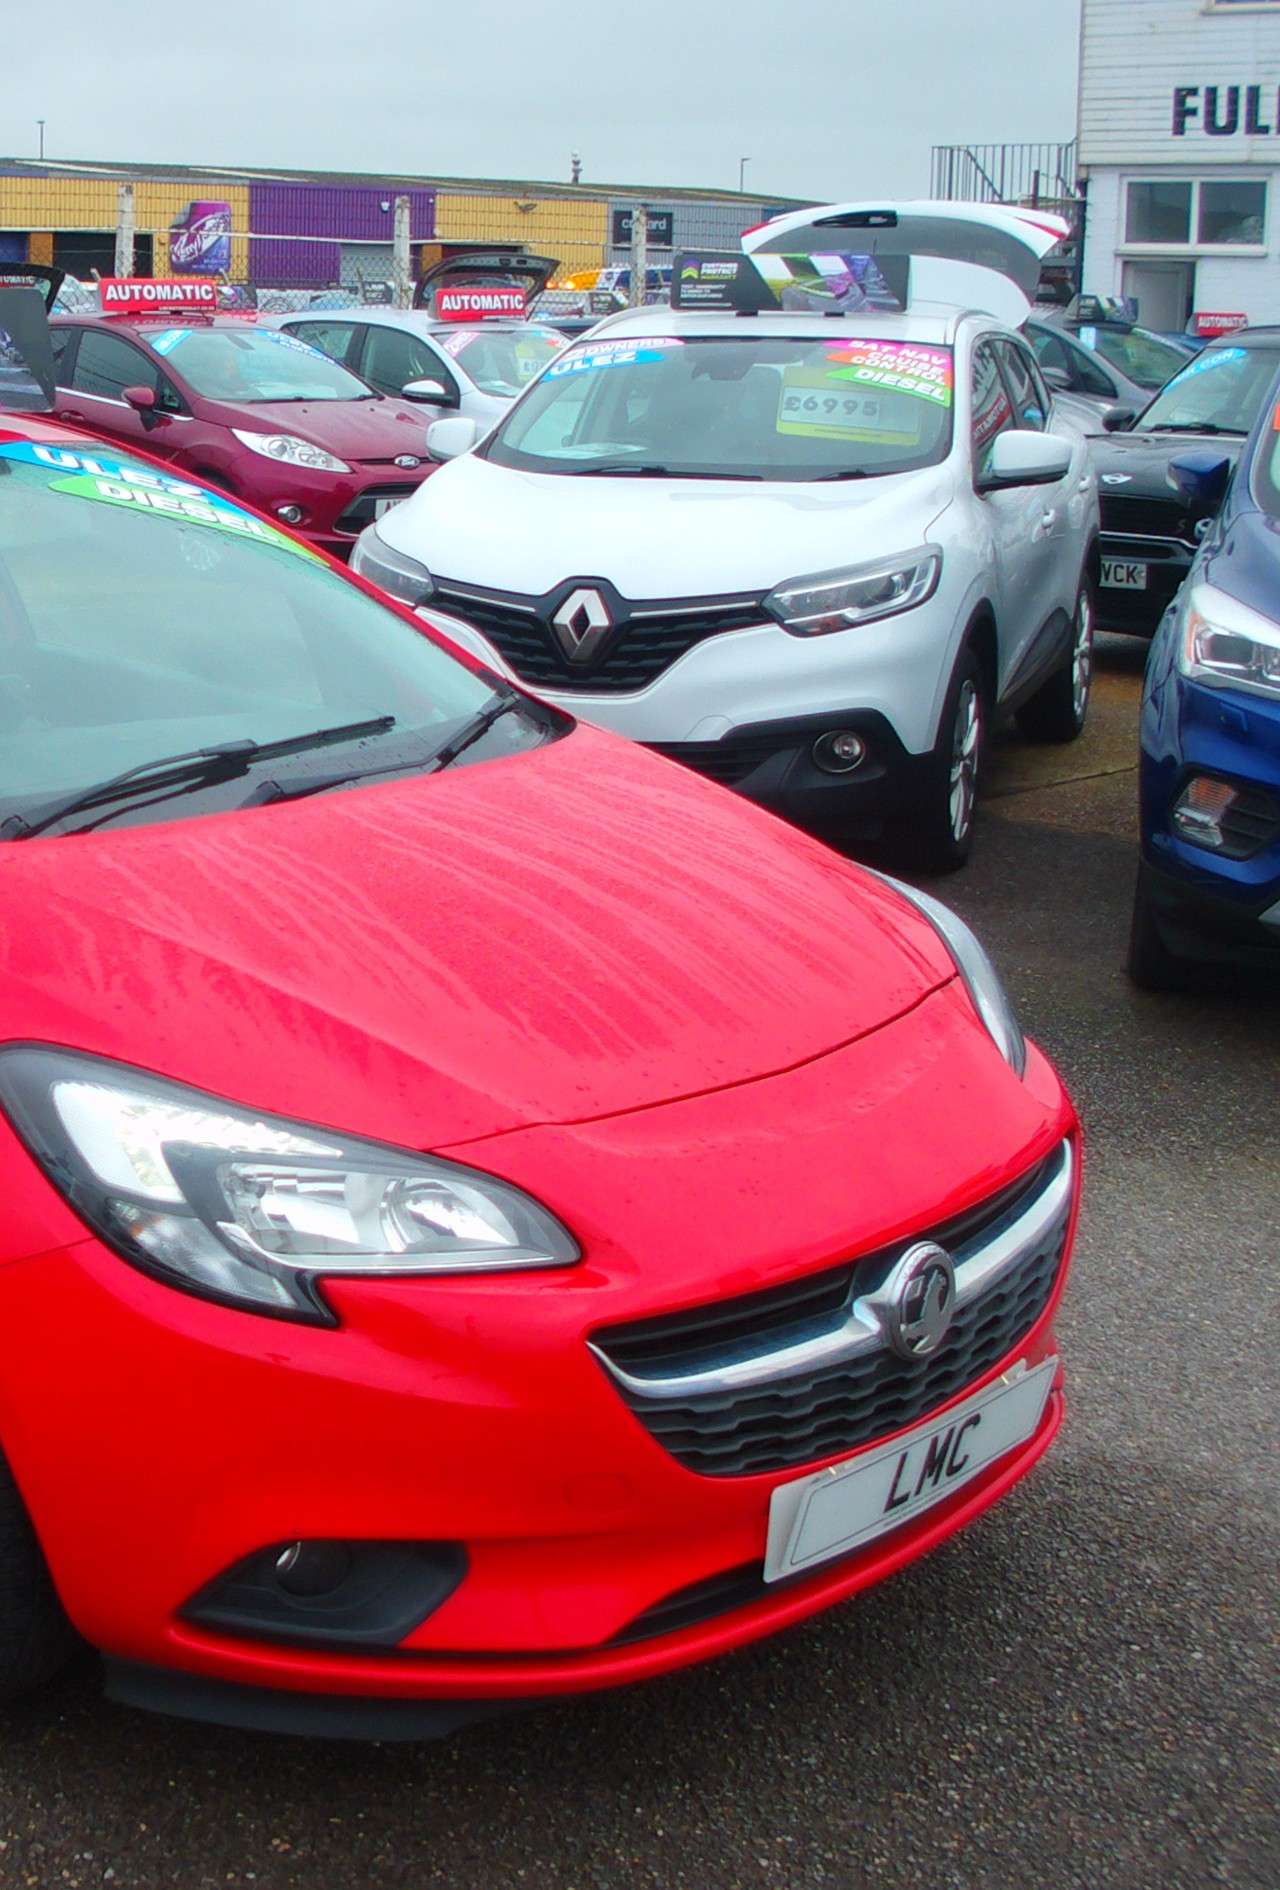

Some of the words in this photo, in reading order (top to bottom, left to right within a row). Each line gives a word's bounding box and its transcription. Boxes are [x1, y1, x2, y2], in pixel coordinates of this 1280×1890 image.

[1172, 85, 1280, 136] FUL
[106, 285, 213, 300] AUTOMATIC
[442, 295, 524, 310] AUTOMATIC
[551, 352, 637, 376] ULEZ
[848, 340, 896, 352] SAT
[899, 349, 948, 365] NAV
[867, 352, 945, 376] CRUISE
[851, 356, 945, 385] CONTROL
[853, 369, 945, 401] DIESEL
[784, 395, 879, 417] £6995
[33, 444, 213, 504] ULEZ
[96, 479, 280, 543] DIESEL
[1101, 563, 1137, 584] VCK
[883, 1413, 981, 1514] LMC
